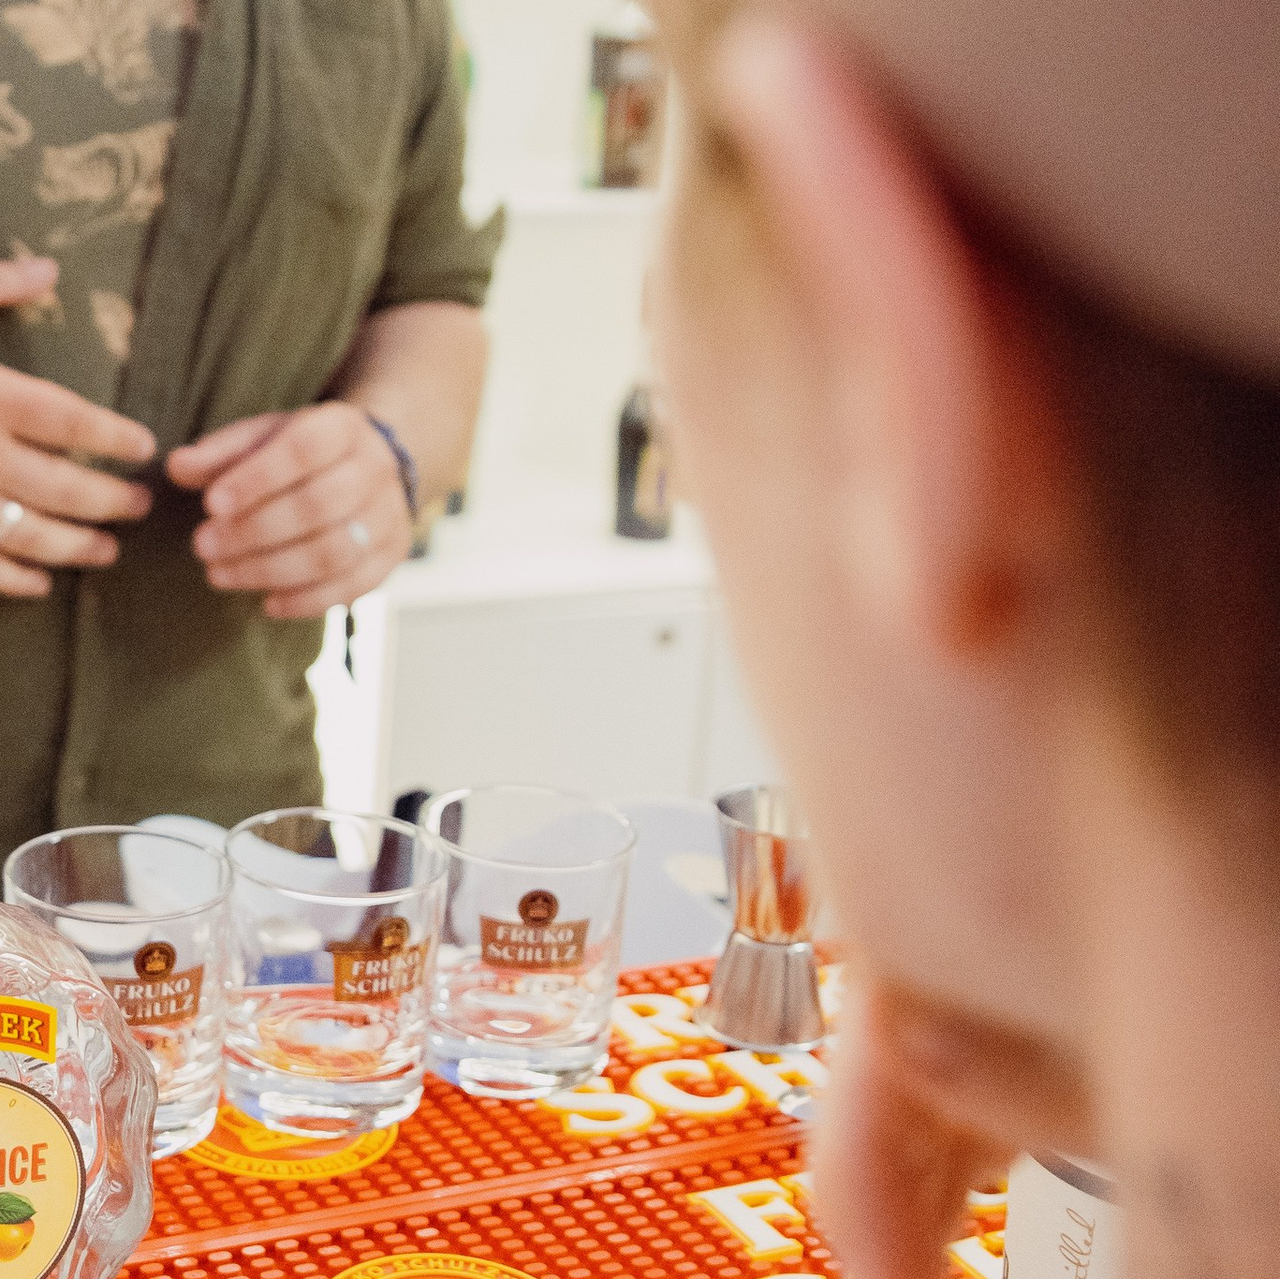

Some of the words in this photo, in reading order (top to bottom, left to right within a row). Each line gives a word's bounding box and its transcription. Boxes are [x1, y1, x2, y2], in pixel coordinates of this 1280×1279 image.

[496, 925, 574, 944] FRUKO
[486, 942, 578, 962] SCHULZ
[113, 978, 191, 999] FRUKO
[120, 993, 195, 1019] CHULZ
[393, 1257, 503, 1279] SCHULZ
